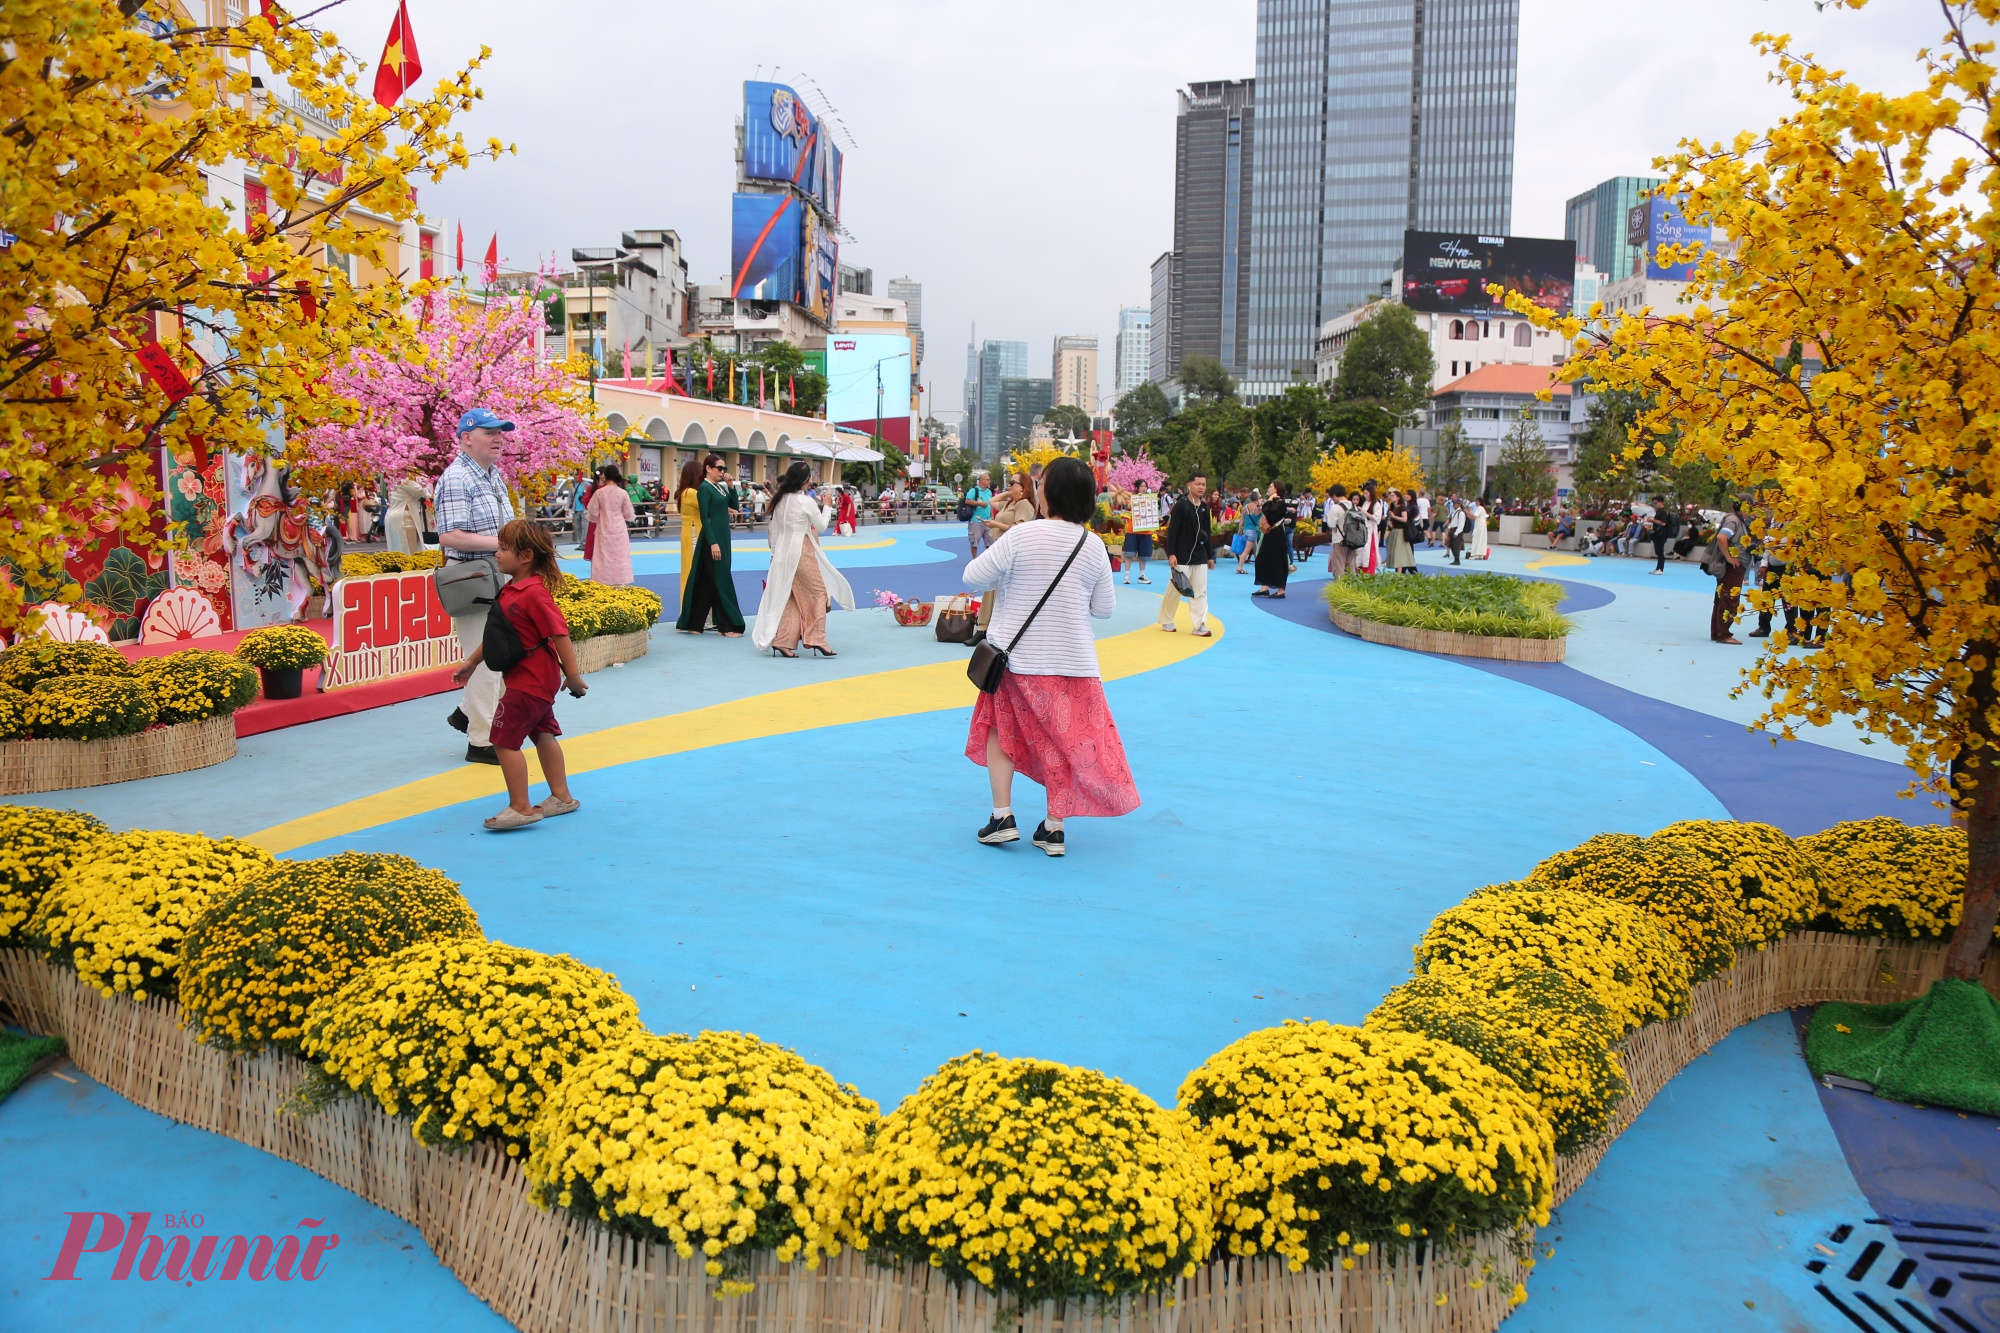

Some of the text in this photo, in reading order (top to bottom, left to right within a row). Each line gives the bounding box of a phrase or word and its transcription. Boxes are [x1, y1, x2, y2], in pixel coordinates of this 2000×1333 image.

[1191, 96, 1221, 105] Keppel
[1628, 229, 1646, 240] HOTEL
[1656, 222, 1682, 238] Sống
[1478, 236, 1504, 245] BIZMAN
[1429, 257, 1482, 270] NEW YEAR
[343, 575, 451, 653] 2026
[326, 642, 382, 687] XUÂN
[389, 637, 431, 675] BÍNH
